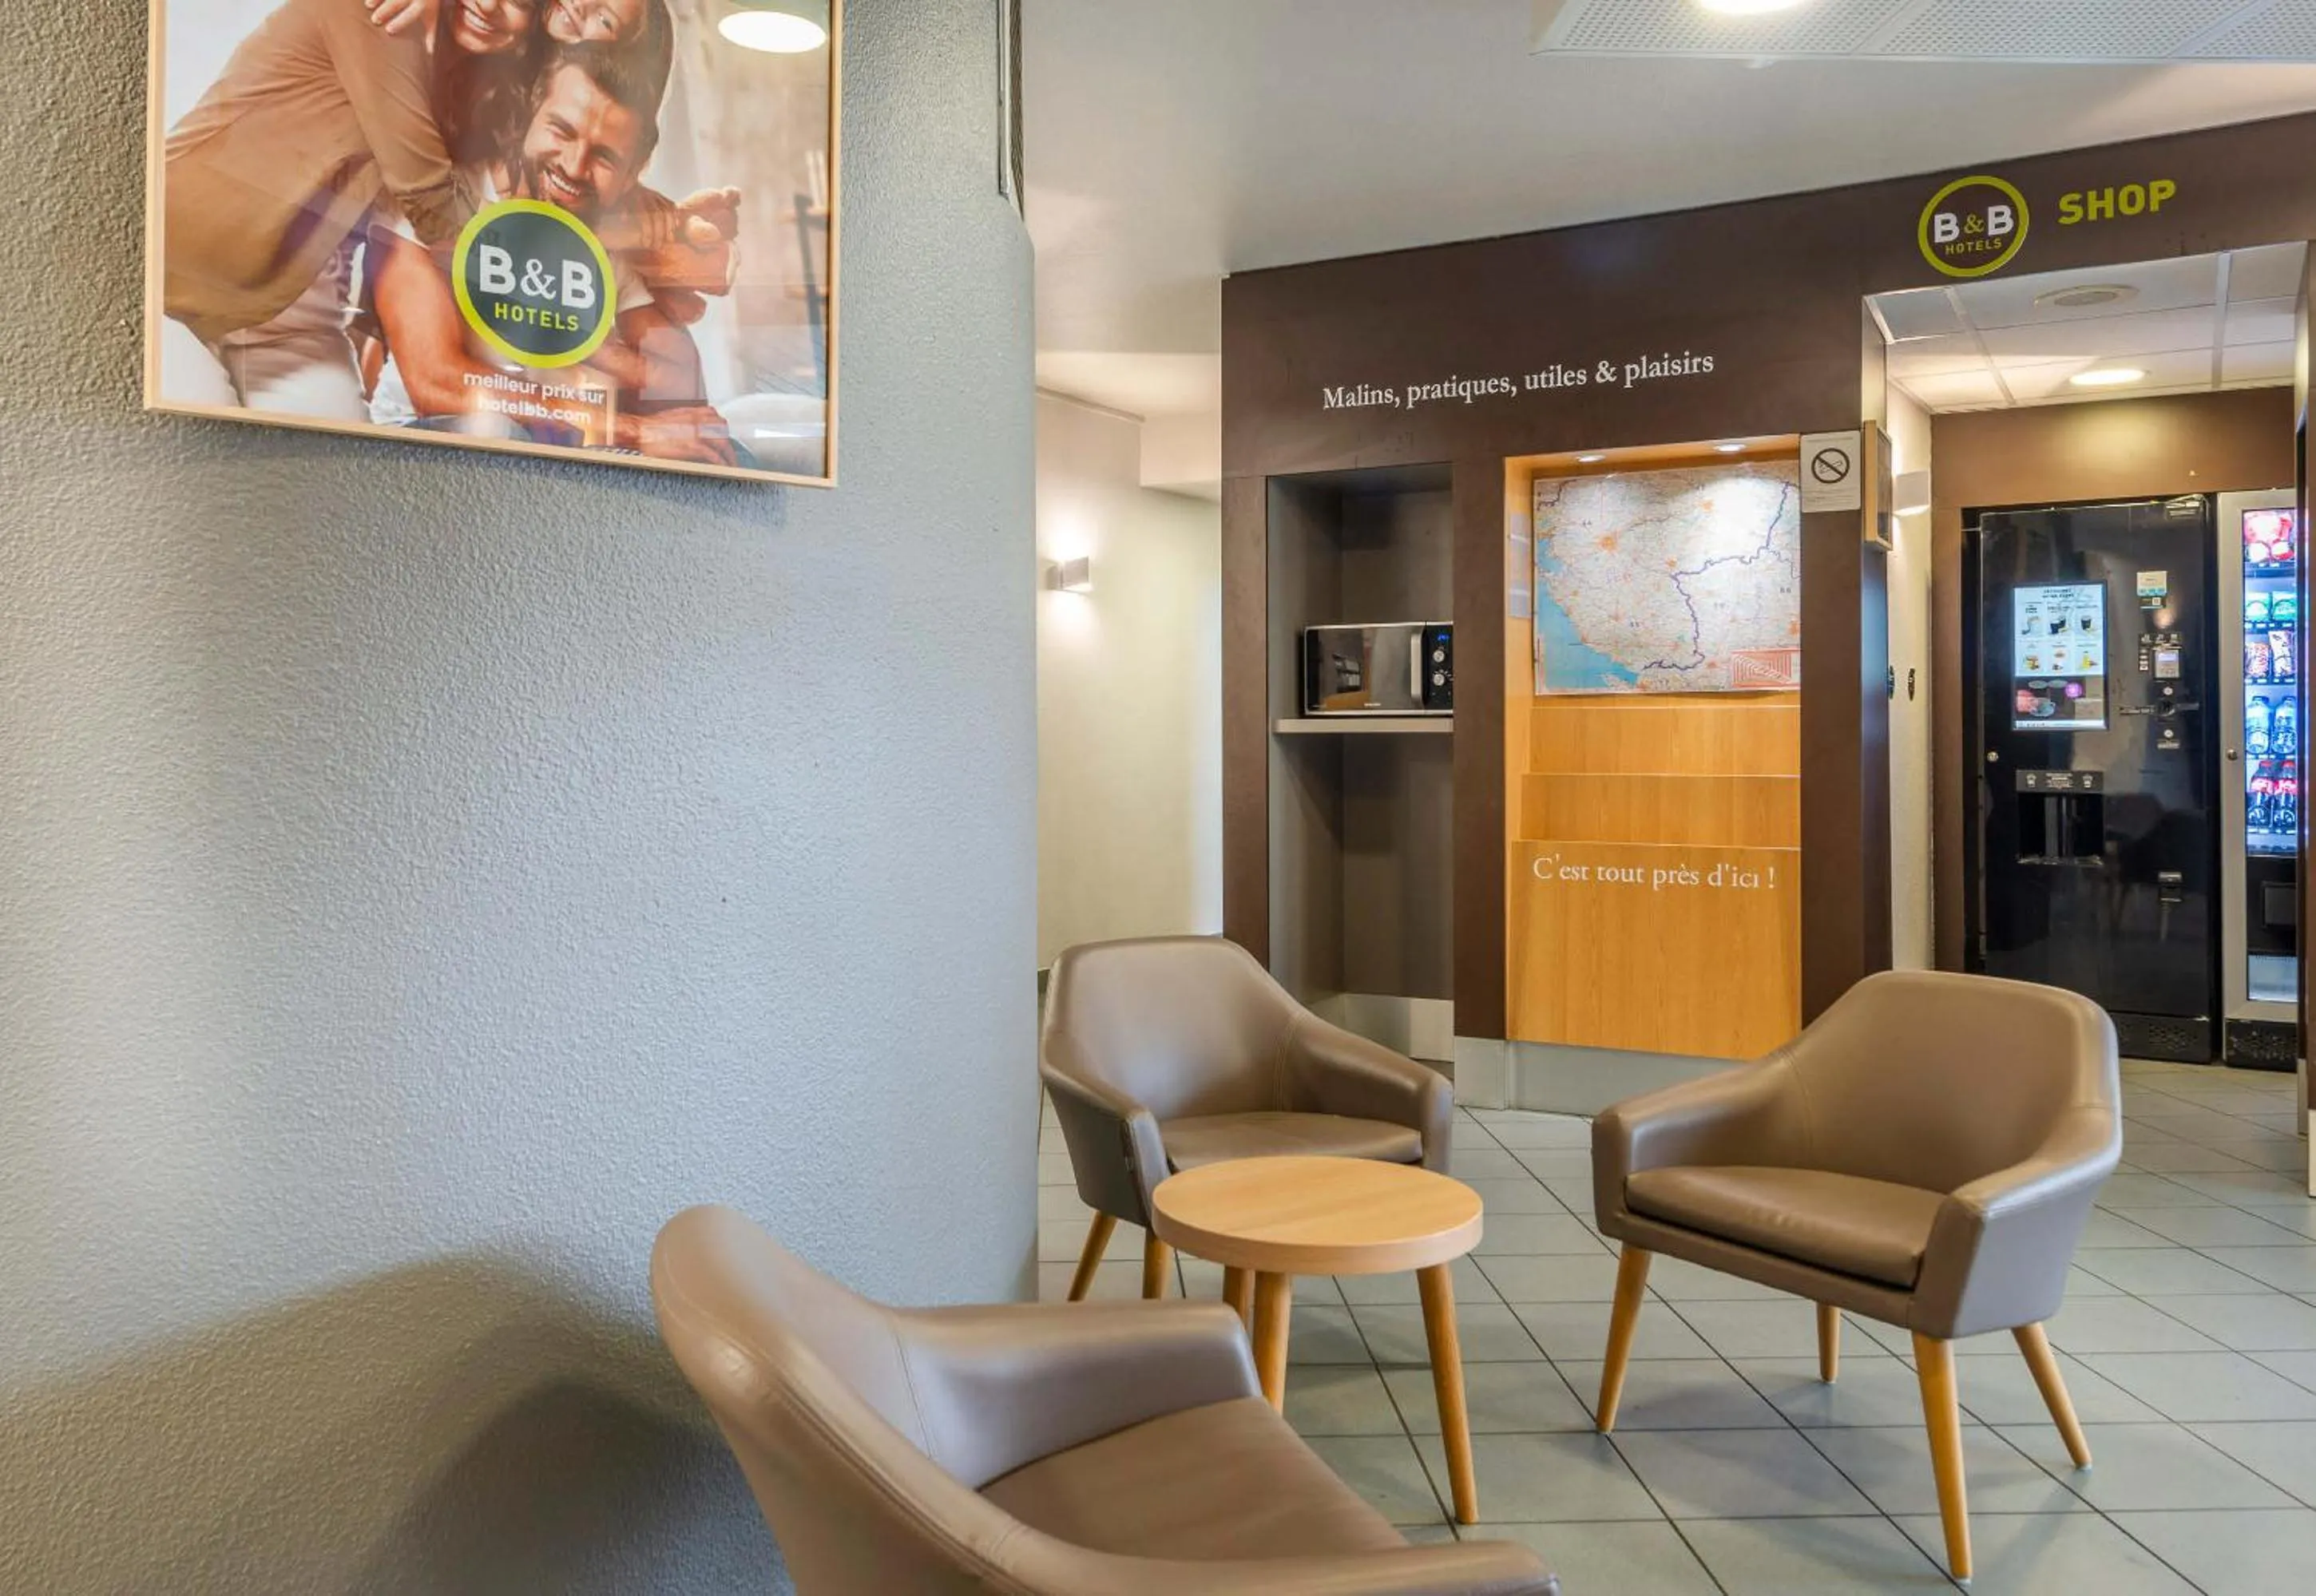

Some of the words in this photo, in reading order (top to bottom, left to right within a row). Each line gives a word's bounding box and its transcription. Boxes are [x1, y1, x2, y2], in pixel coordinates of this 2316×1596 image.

[2057, 179, 2176, 225] SHOP
[1933, 204, 2014, 244] B&B
[1945, 238, 2002, 255] HOTELS
[479, 243, 596, 309] B&B
[494, 302, 580, 332] HOTELS
[463, 372, 539, 395] meilleur
[541, 382, 577, 401] prix
[578, 388, 605, 406] sur
[1323, 384, 1402, 410] Malins,
[1406, 373, 1518, 410] pratiques,
[1524, 364, 1588, 390] utiles
[1596, 359, 1617, 383] &
[1624, 350, 1715, 388] plaisirs
[1533, 853, 1589, 881] C'est
[1596, 865, 1645, 884] tout
[1652, 863, 1700, 892] près
[1707, 863, 1761, 889] d'ici
